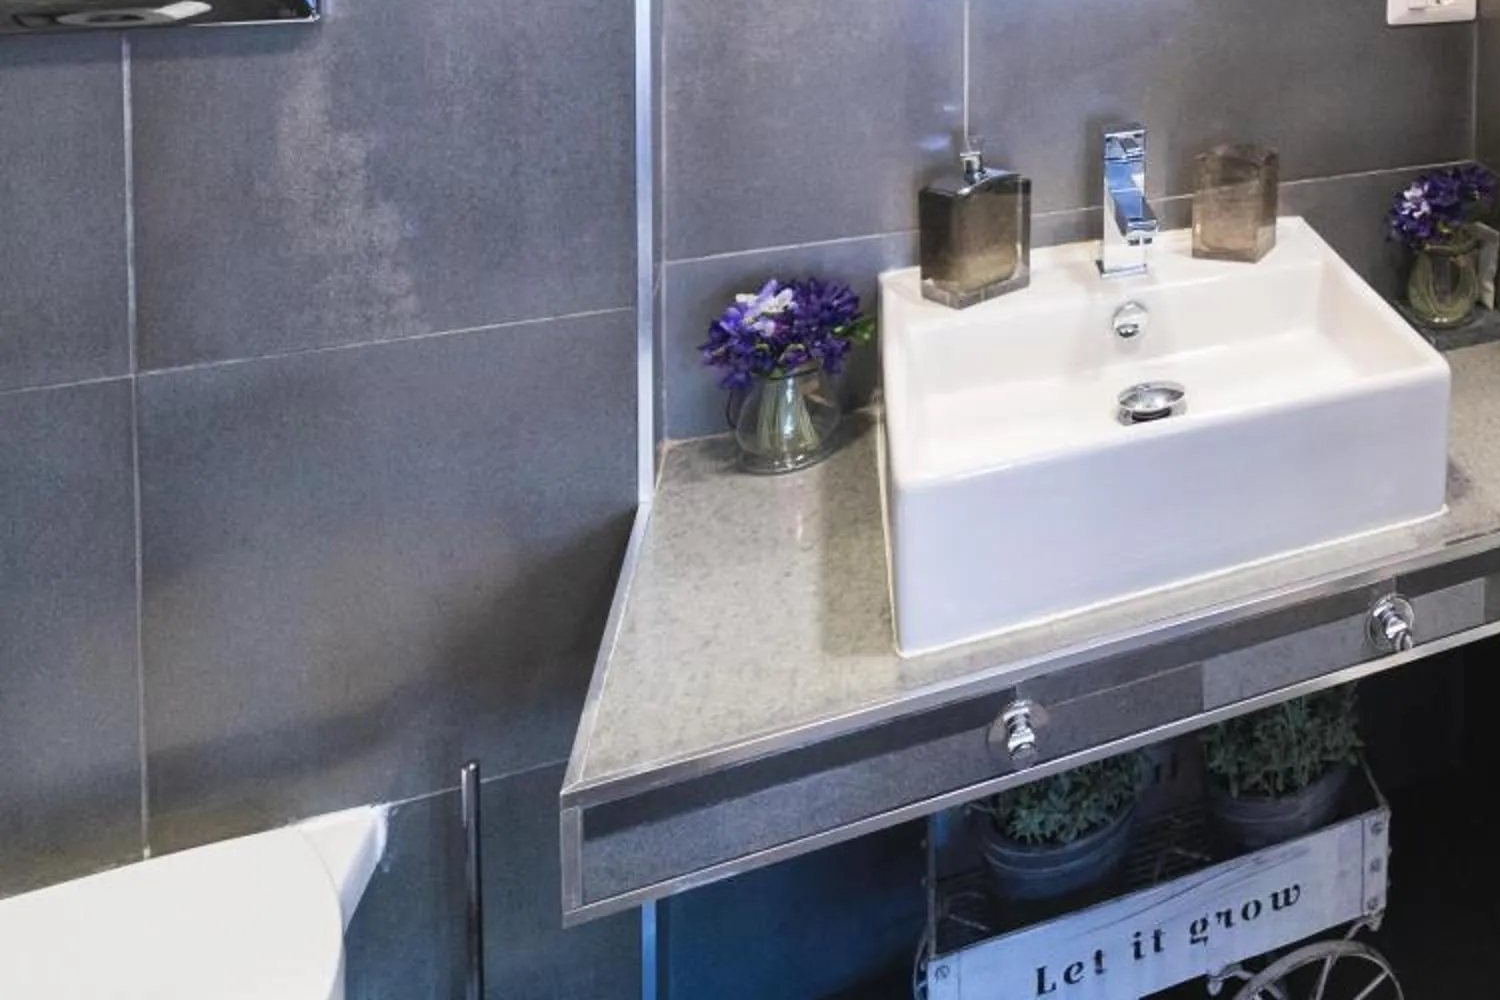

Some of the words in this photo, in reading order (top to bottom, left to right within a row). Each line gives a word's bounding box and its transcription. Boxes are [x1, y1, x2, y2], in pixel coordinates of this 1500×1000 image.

[1034, 948, 1107, 997] Let
[1132, 929, 1165, 962] it
[1188, 880, 1302, 947] grow
